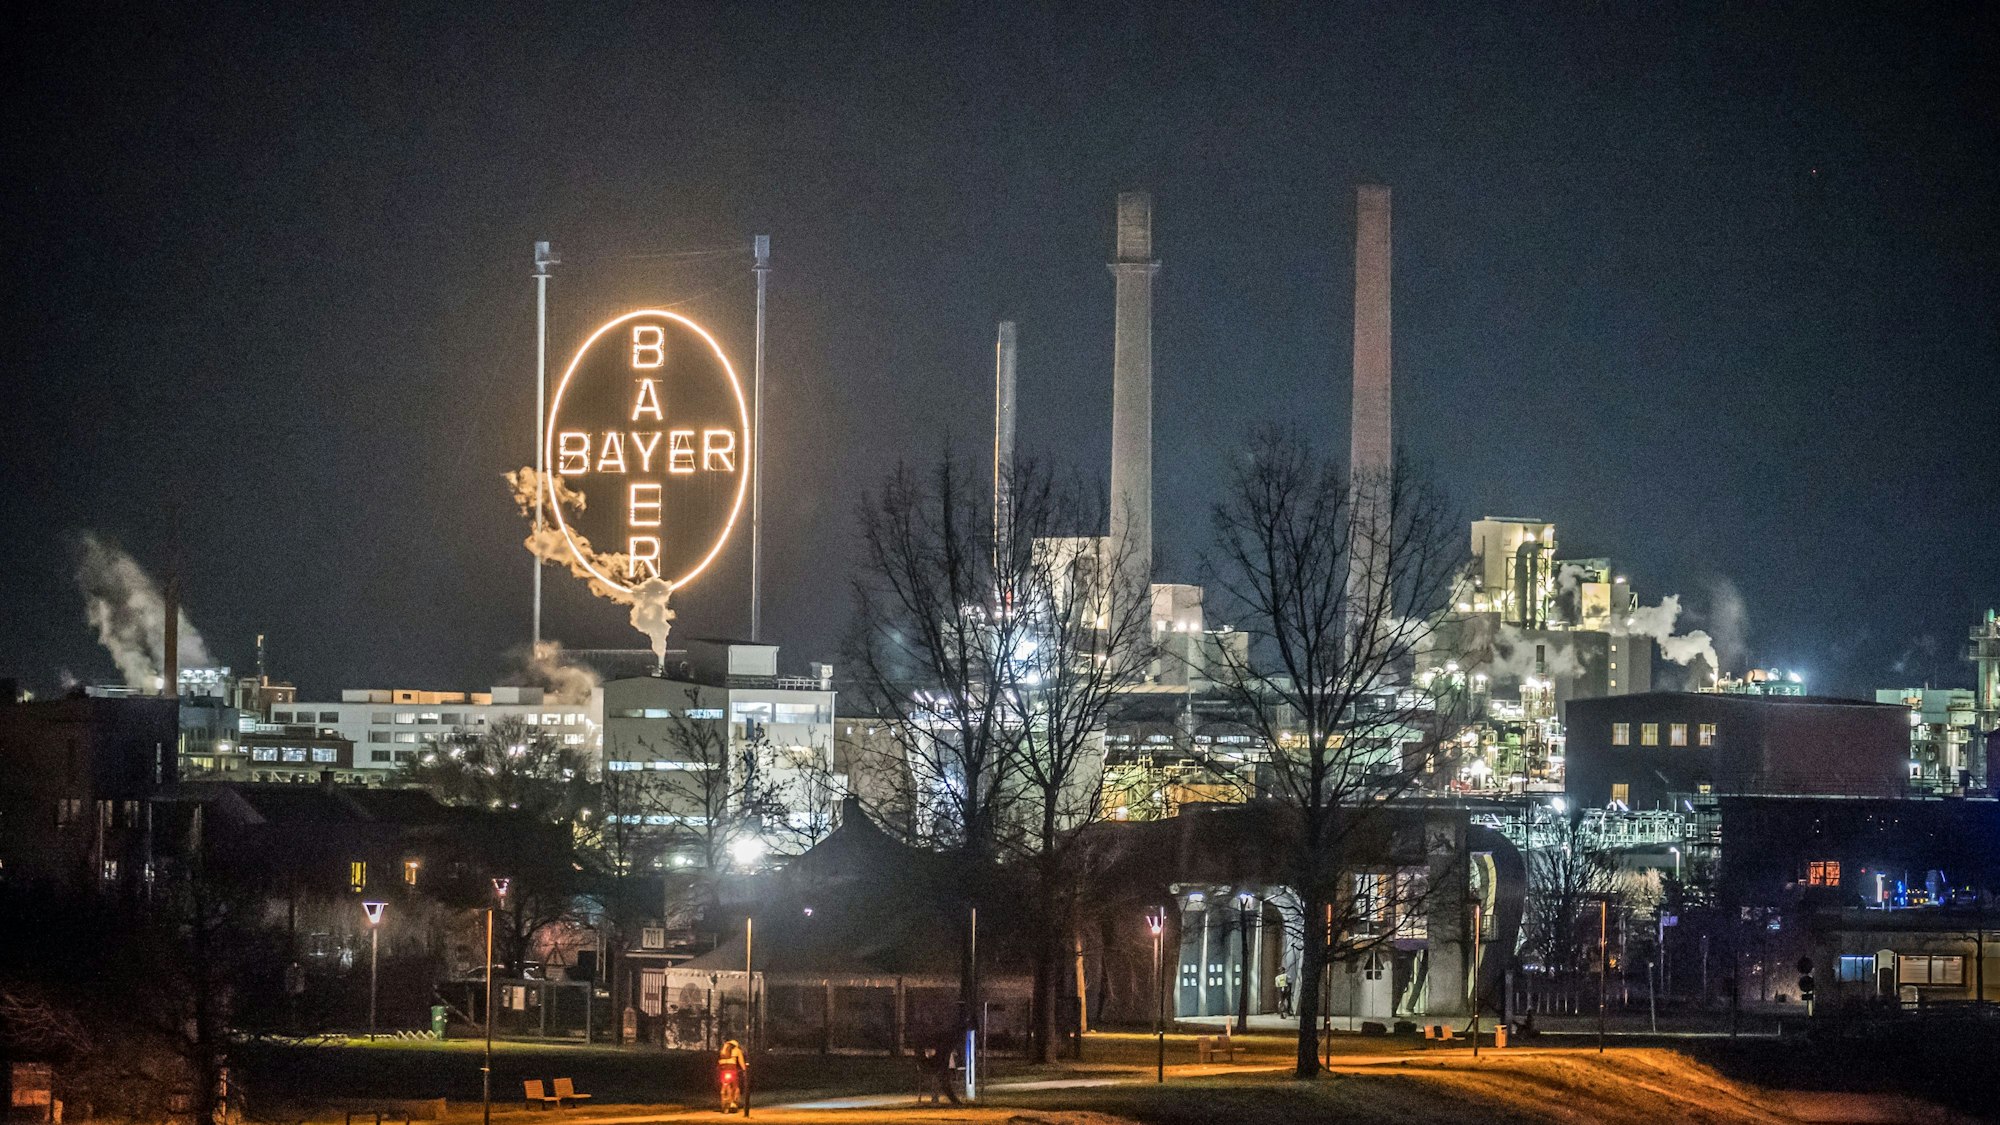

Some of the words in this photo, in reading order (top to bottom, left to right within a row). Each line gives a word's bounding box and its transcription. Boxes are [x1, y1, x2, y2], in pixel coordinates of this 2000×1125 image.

[558, 429, 736, 475] BAYER
[629, 325, 665, 579] BAYER
[645, 930, 660, 946] 701
